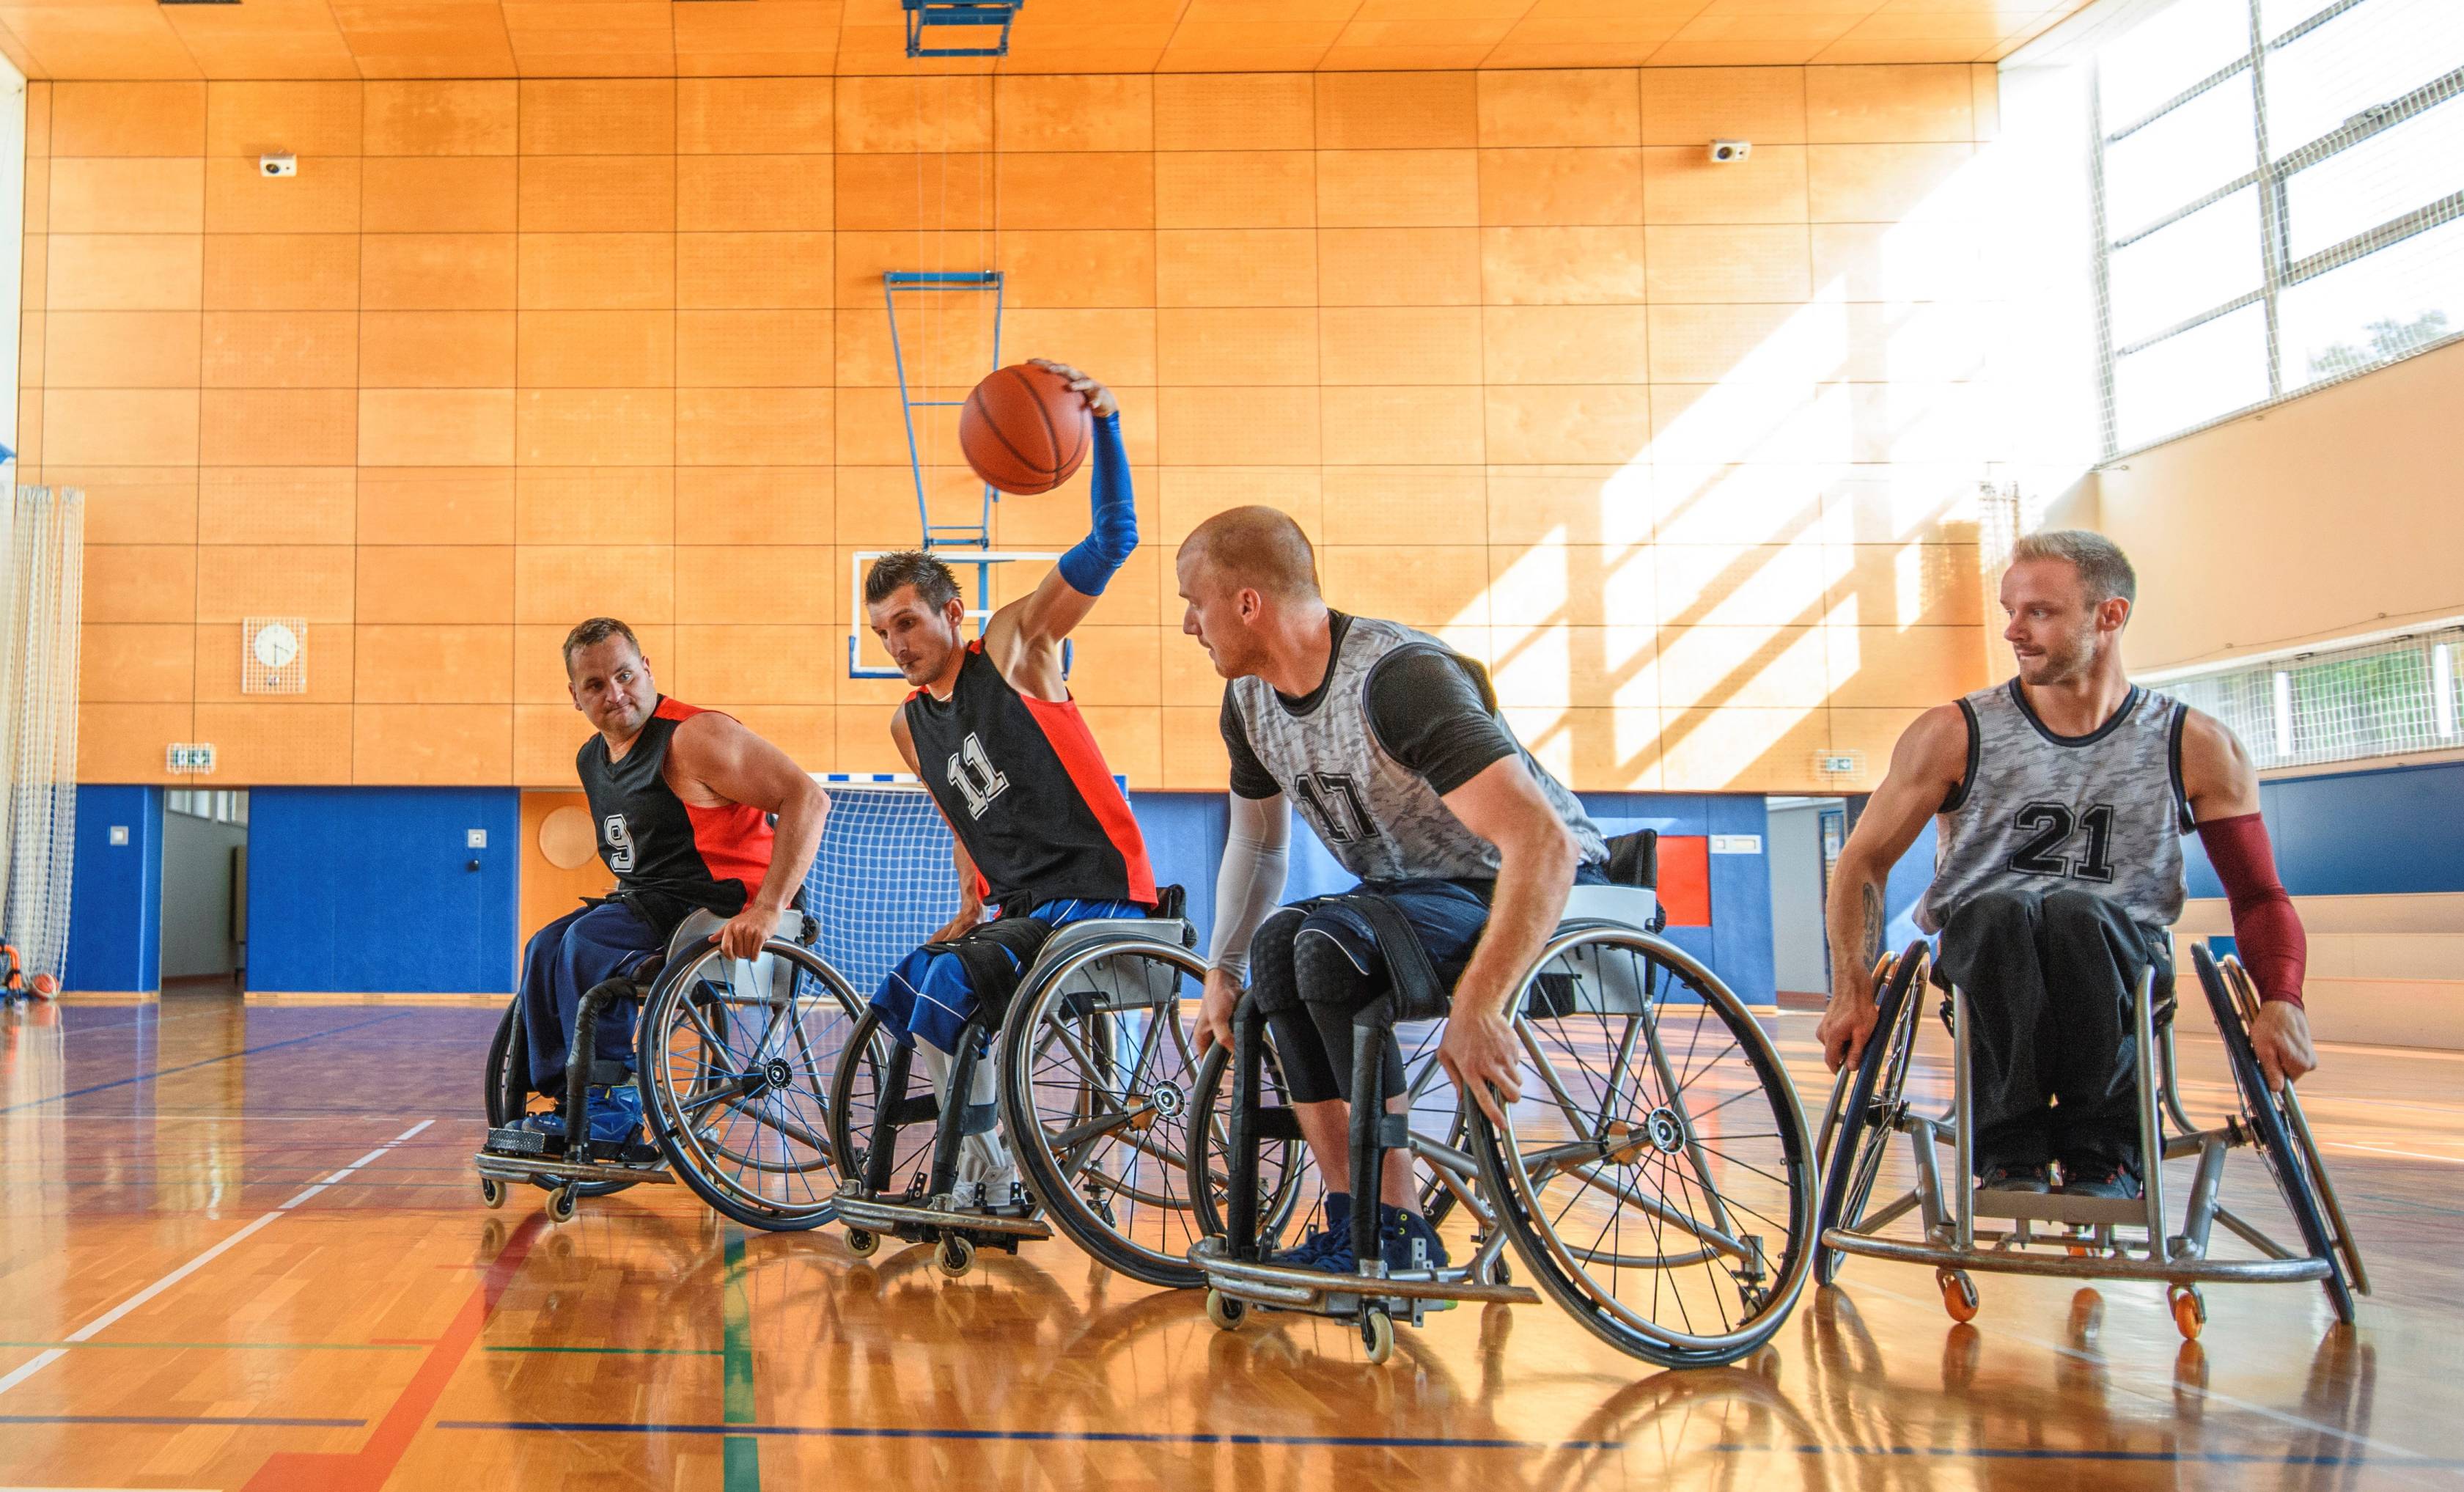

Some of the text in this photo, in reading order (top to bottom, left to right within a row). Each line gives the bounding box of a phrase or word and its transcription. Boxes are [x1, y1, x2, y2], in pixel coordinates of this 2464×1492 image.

[947, 731, 1010, 821] 11
[1294, 771, 1381, 843] 17
[603, 813, 636, 872] 9
[2007, 801, 2114, 884] 21
